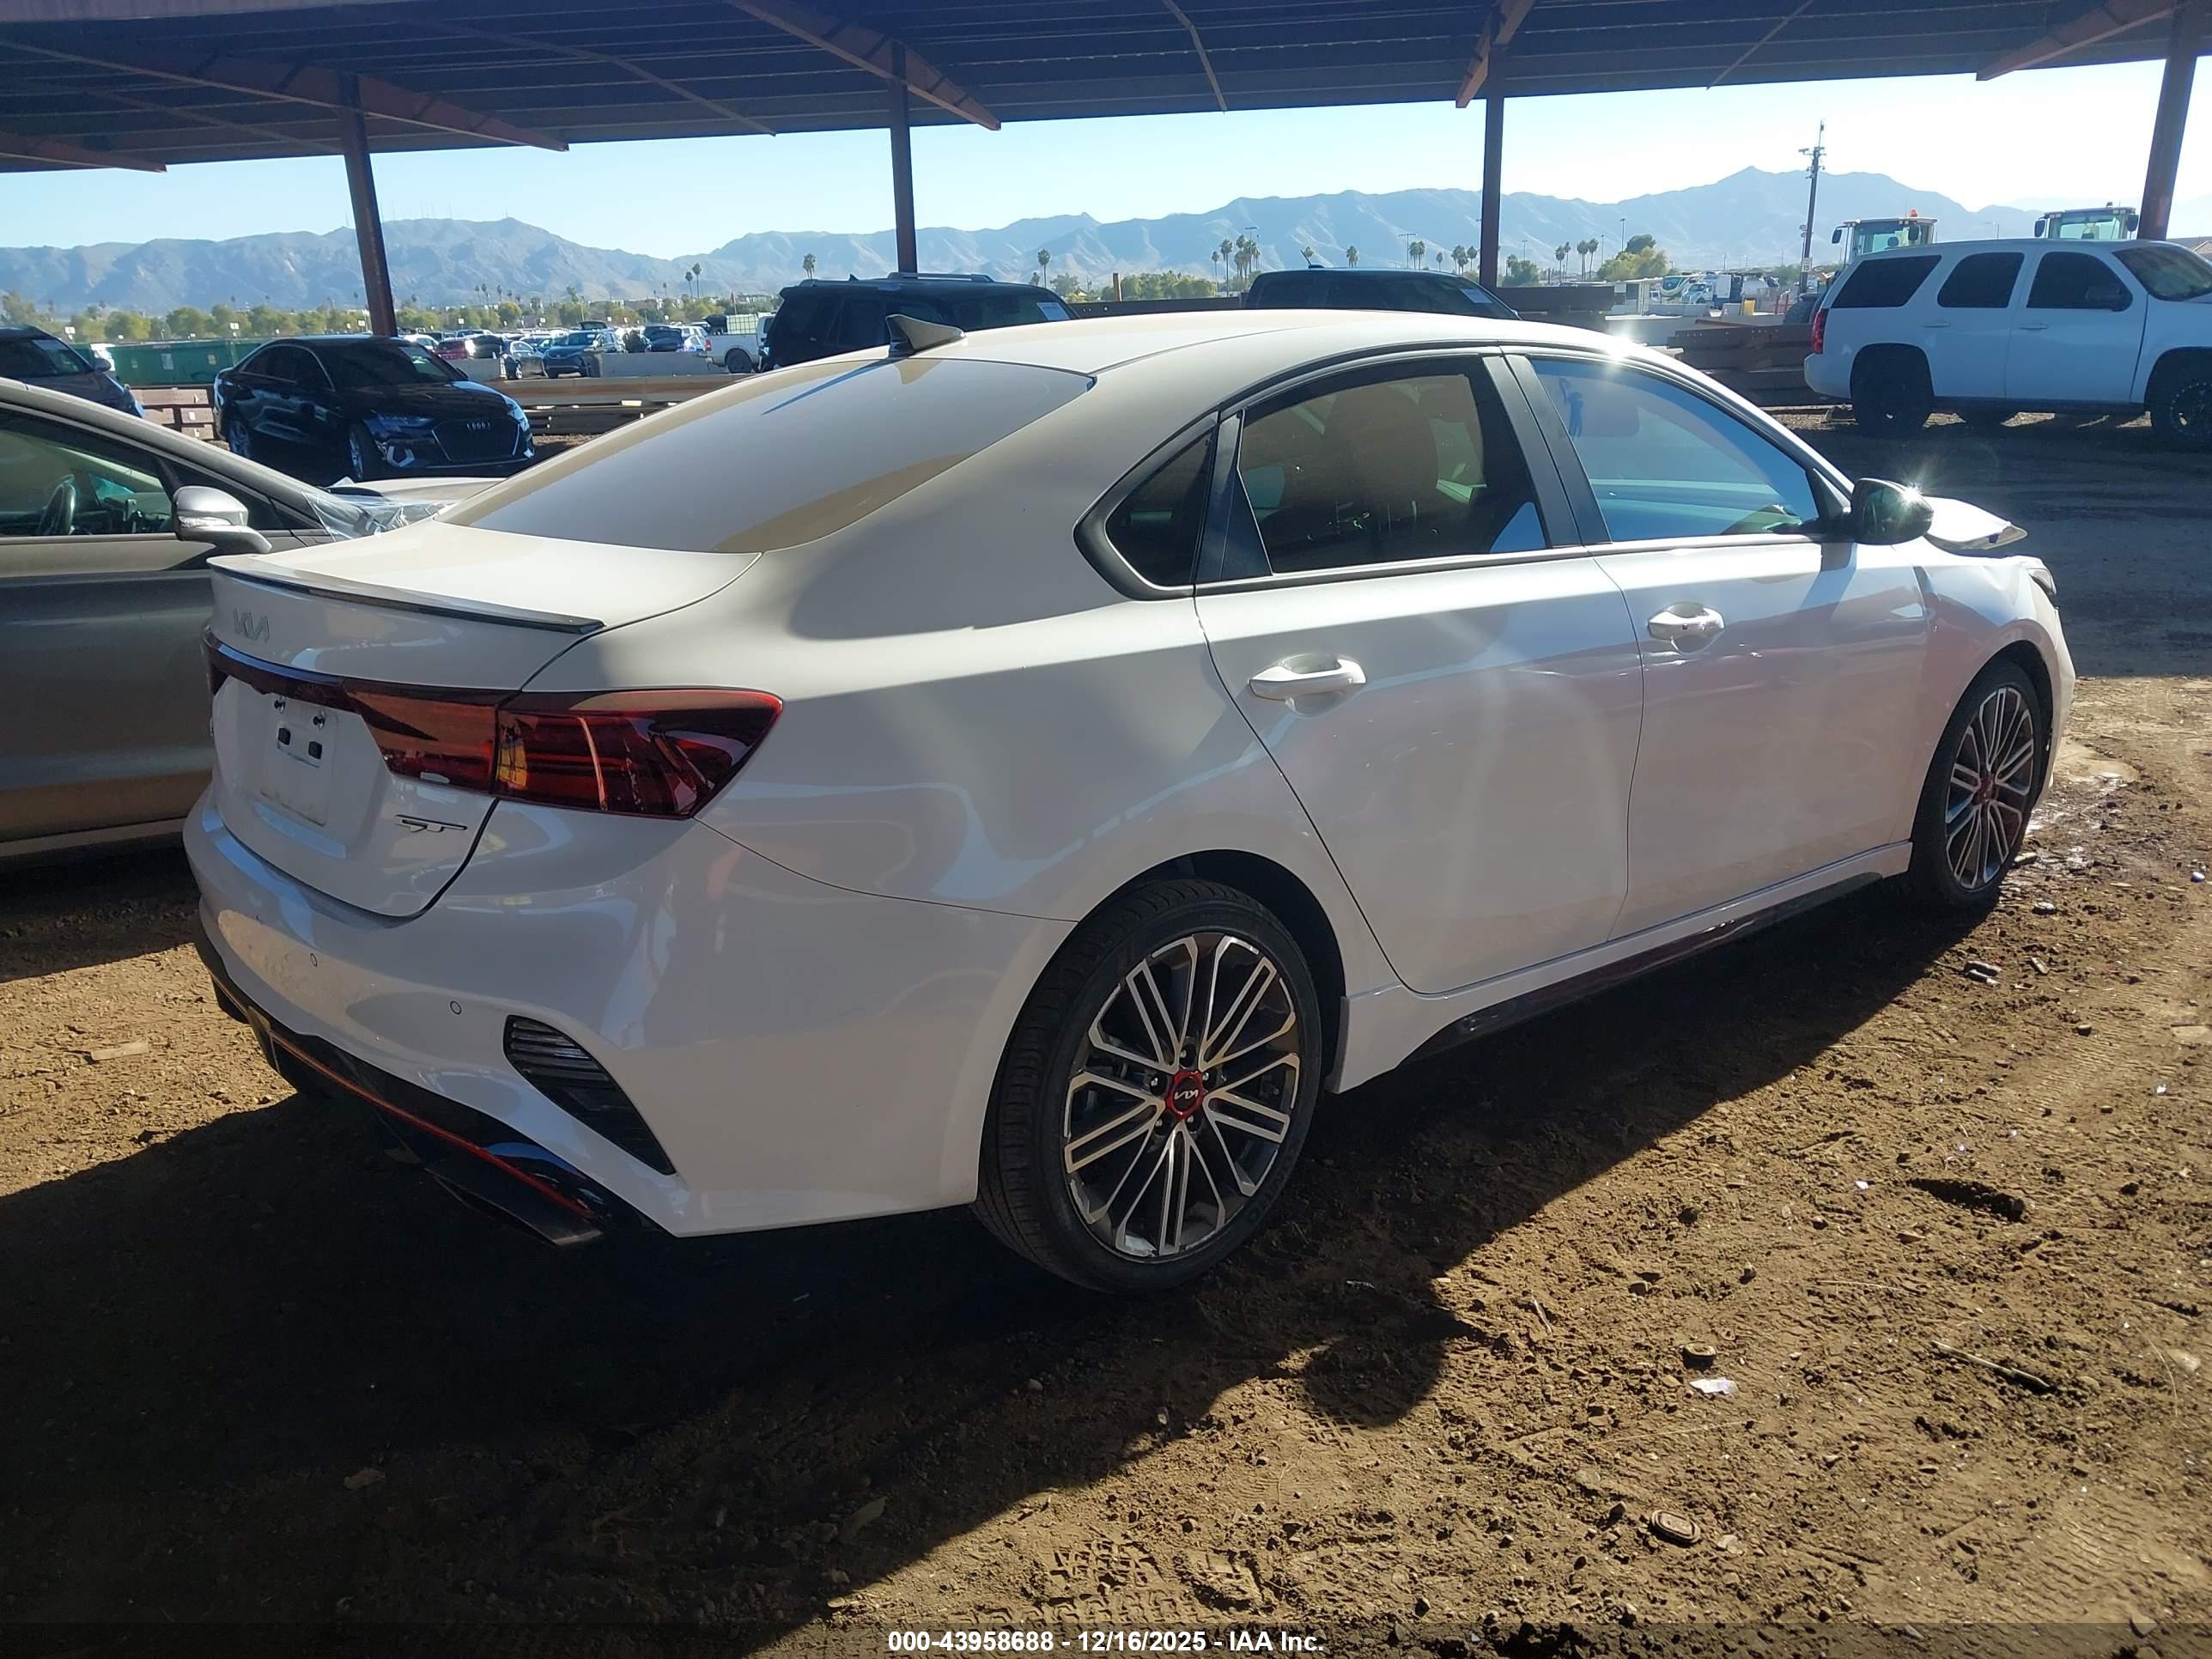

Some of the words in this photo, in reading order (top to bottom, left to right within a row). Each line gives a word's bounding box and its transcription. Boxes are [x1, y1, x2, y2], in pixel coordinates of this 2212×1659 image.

[233, 606, 270, 644] KIA
[393, 813, 468, 833] GT
[1174, 1089, 1199, 1100] KIA
